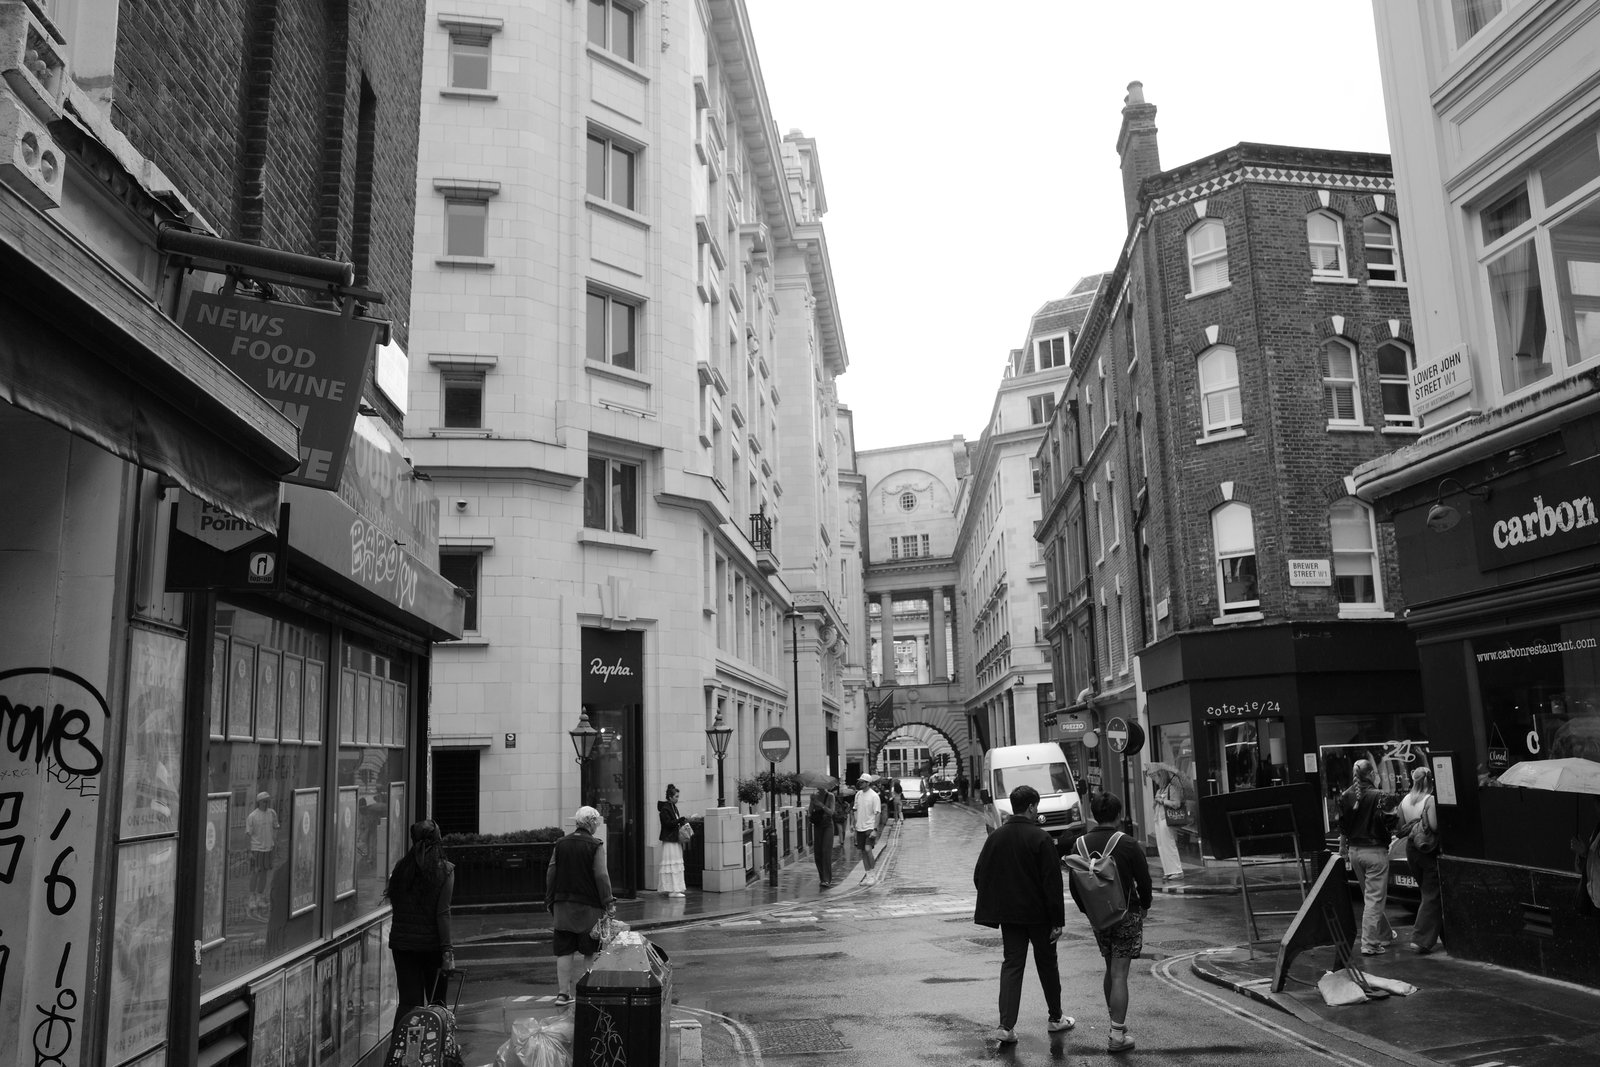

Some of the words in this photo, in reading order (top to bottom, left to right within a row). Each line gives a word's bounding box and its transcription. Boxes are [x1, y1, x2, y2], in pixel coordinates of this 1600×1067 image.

[197, 304, 285, 337] NEWS
[231, 335, 316, 369] FOOD
[1413, 364, 1439, 387] LOWER
[1440, 352, 1461, 373] JOHN
[266, 367, 346, 402] WINE
[1415, 376, 1442, 400] STREET
[1444, 370, 1456, 386] W1
[200, 515, 254, 531] Point
[1492, 494, 1599, 550] carbon
[1292, 562, 1319, 570] BREWER
[1293, 570, 1316, 578] STREET
[1317, 570, 1328, 578] W1
[1476, 637, 1597, 662] www.carbonrestaurant.com
[1206, 700, 1282, 717] coterie/24
[1062, 722, 1085, 730] PREZZO
[1382, 739, 1416, 763] 24
[46, 756, 100, 798] KOZE
[230, 753, 297, 782] NEWSPAPERS
[208, 799, 228, 815] ISSUE
